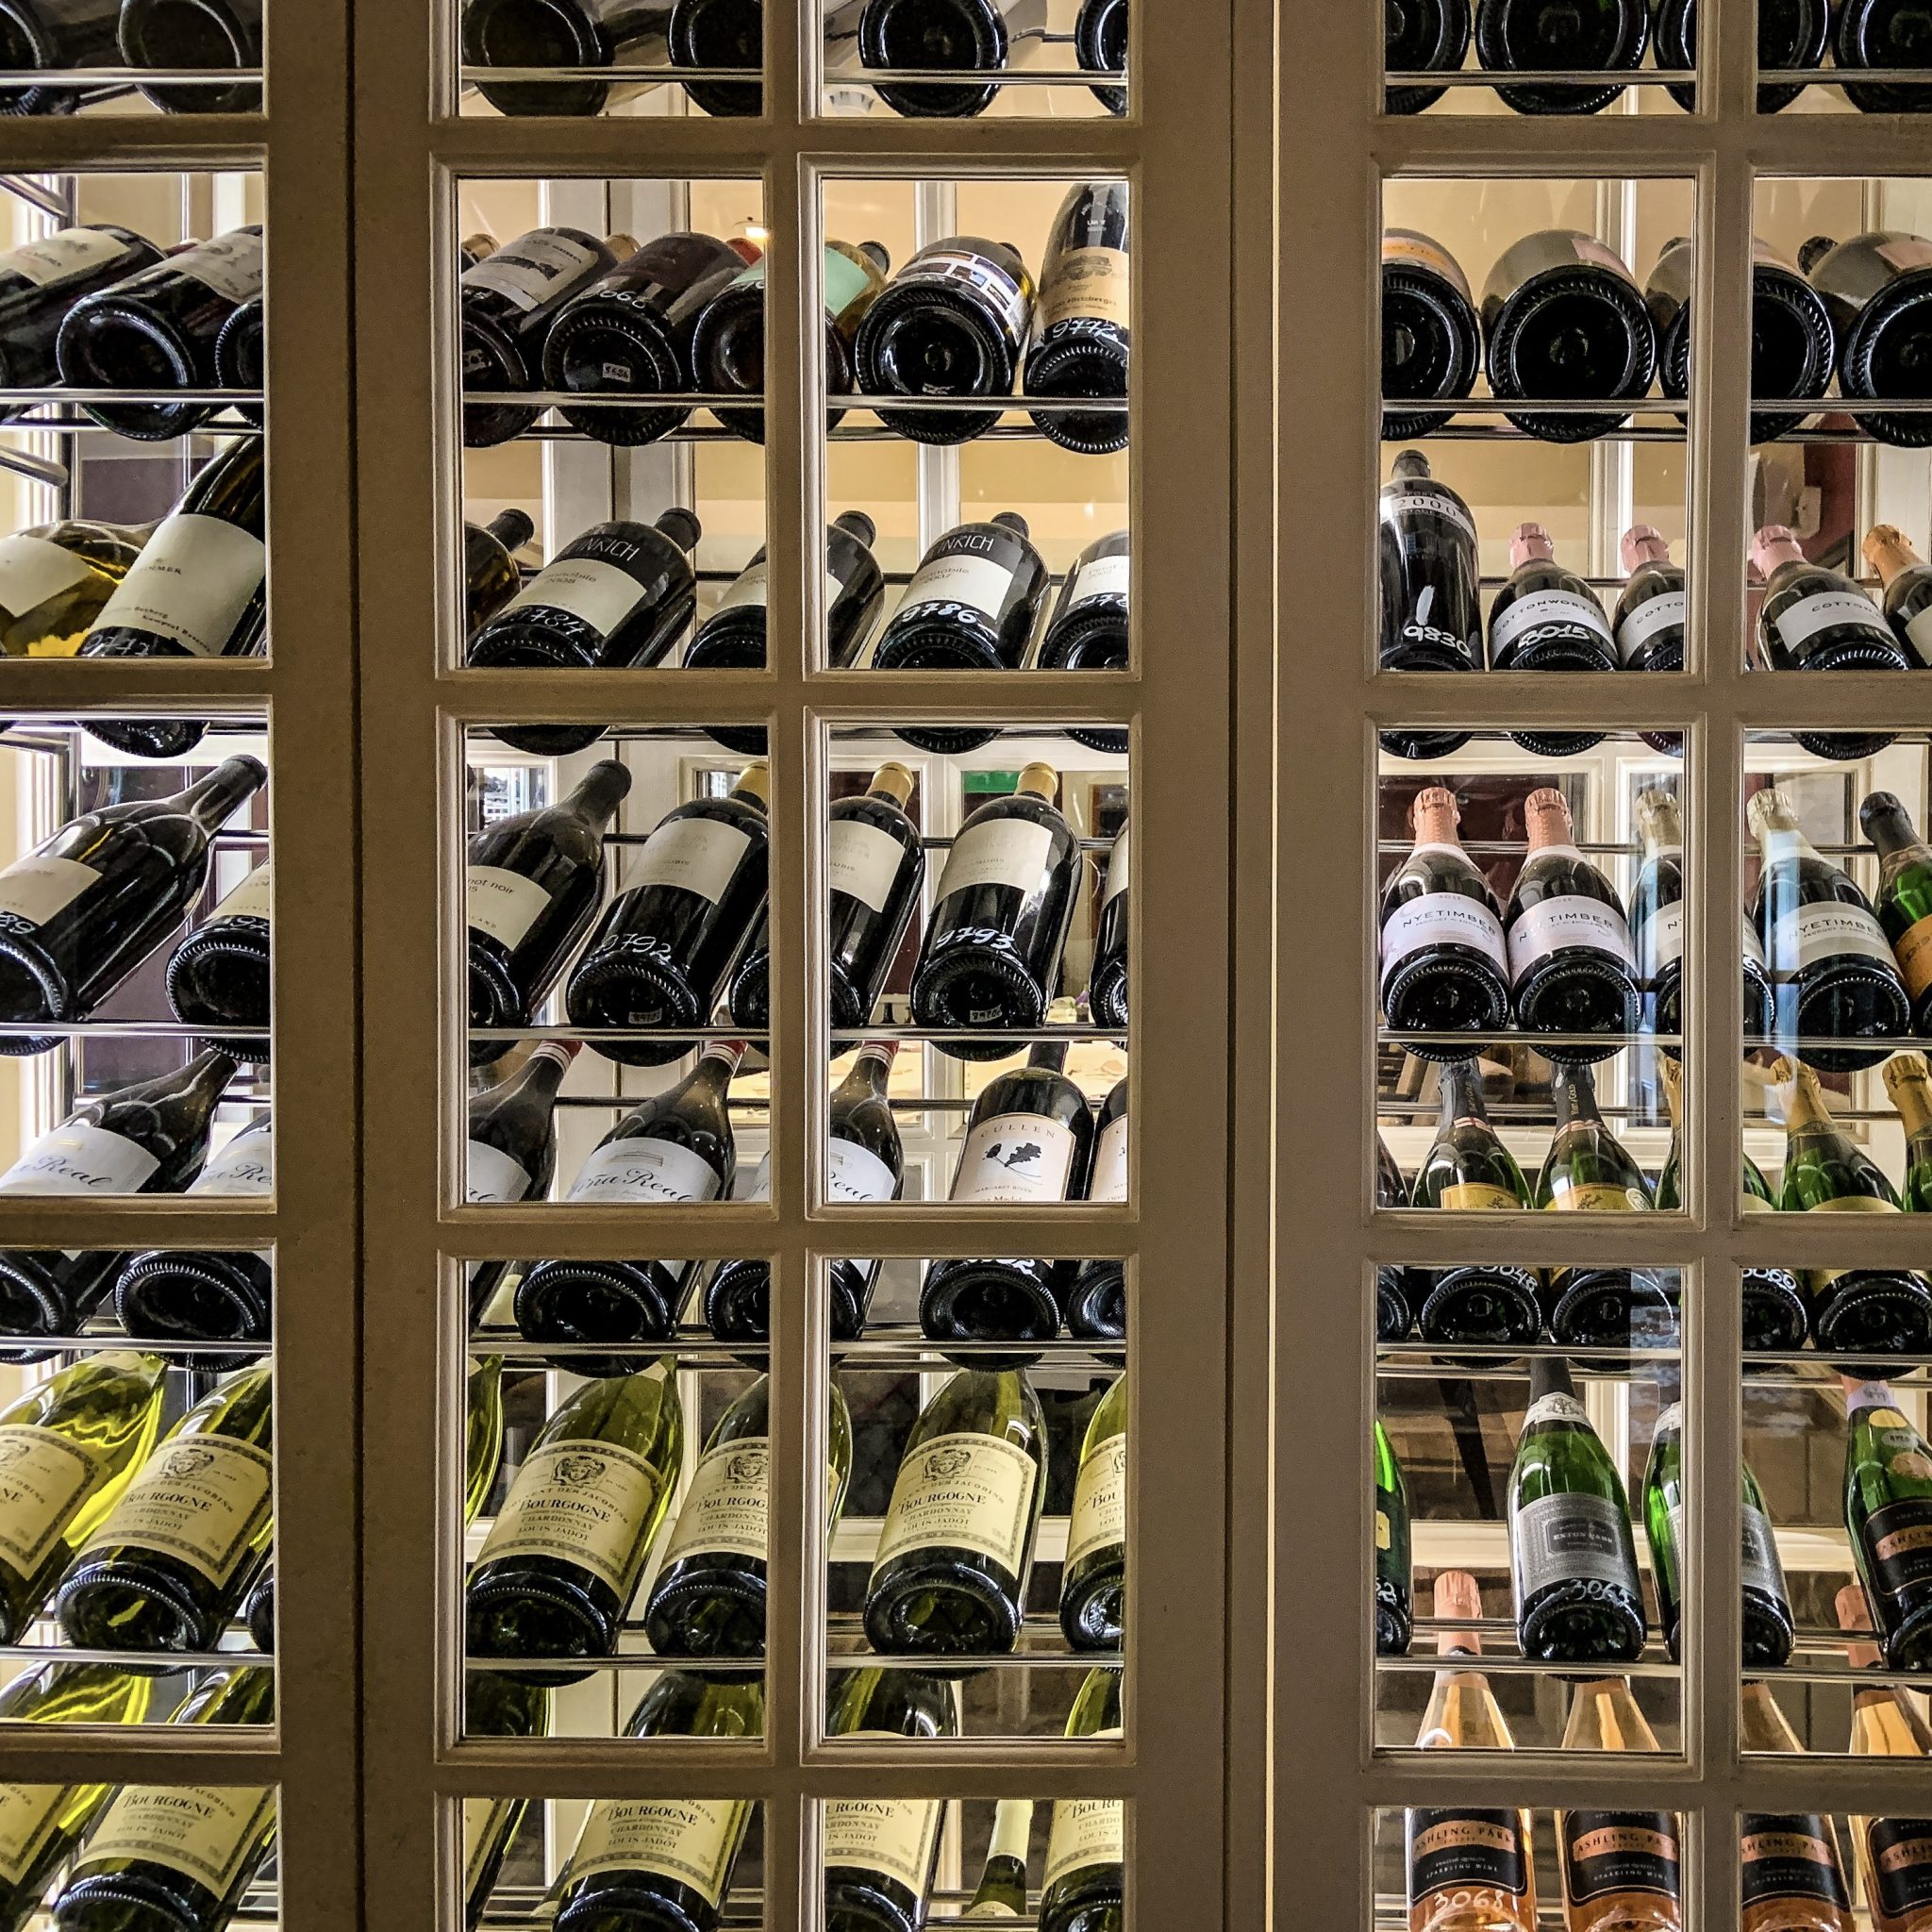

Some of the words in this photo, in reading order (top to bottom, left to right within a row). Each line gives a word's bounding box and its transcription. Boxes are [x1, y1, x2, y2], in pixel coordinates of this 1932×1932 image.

[1398, 497, 1457, 517] 2000
[902, 603, 980, 623] 9786
[1404, 625, 1472, 658] 9830
[491, 882, 514, 894] noir
[1403, 910, 1496, 937] NYETIMBER
[935, 927, 1015, 950] 9793
[981, 1124, 1055, 1139] CULLEN
[35, 1155, 112, 1187] Real
[520, 1498, 611, 1523] BOURGOGNE
[898, 1491, 988, 1515] BOURGOGNE
[124, 1795, 215, 1818] BOURGOGNE
[608, 1806, 698, 1825] BOURGOGNE
[1416, 1827, 1470, 1850] ASHLING
[1478, 1827, 1510, 1842] PARK
[1578, 1834, 1638, 1852] ASHLING
[1434, 1890, 1505, 1917] 3068
